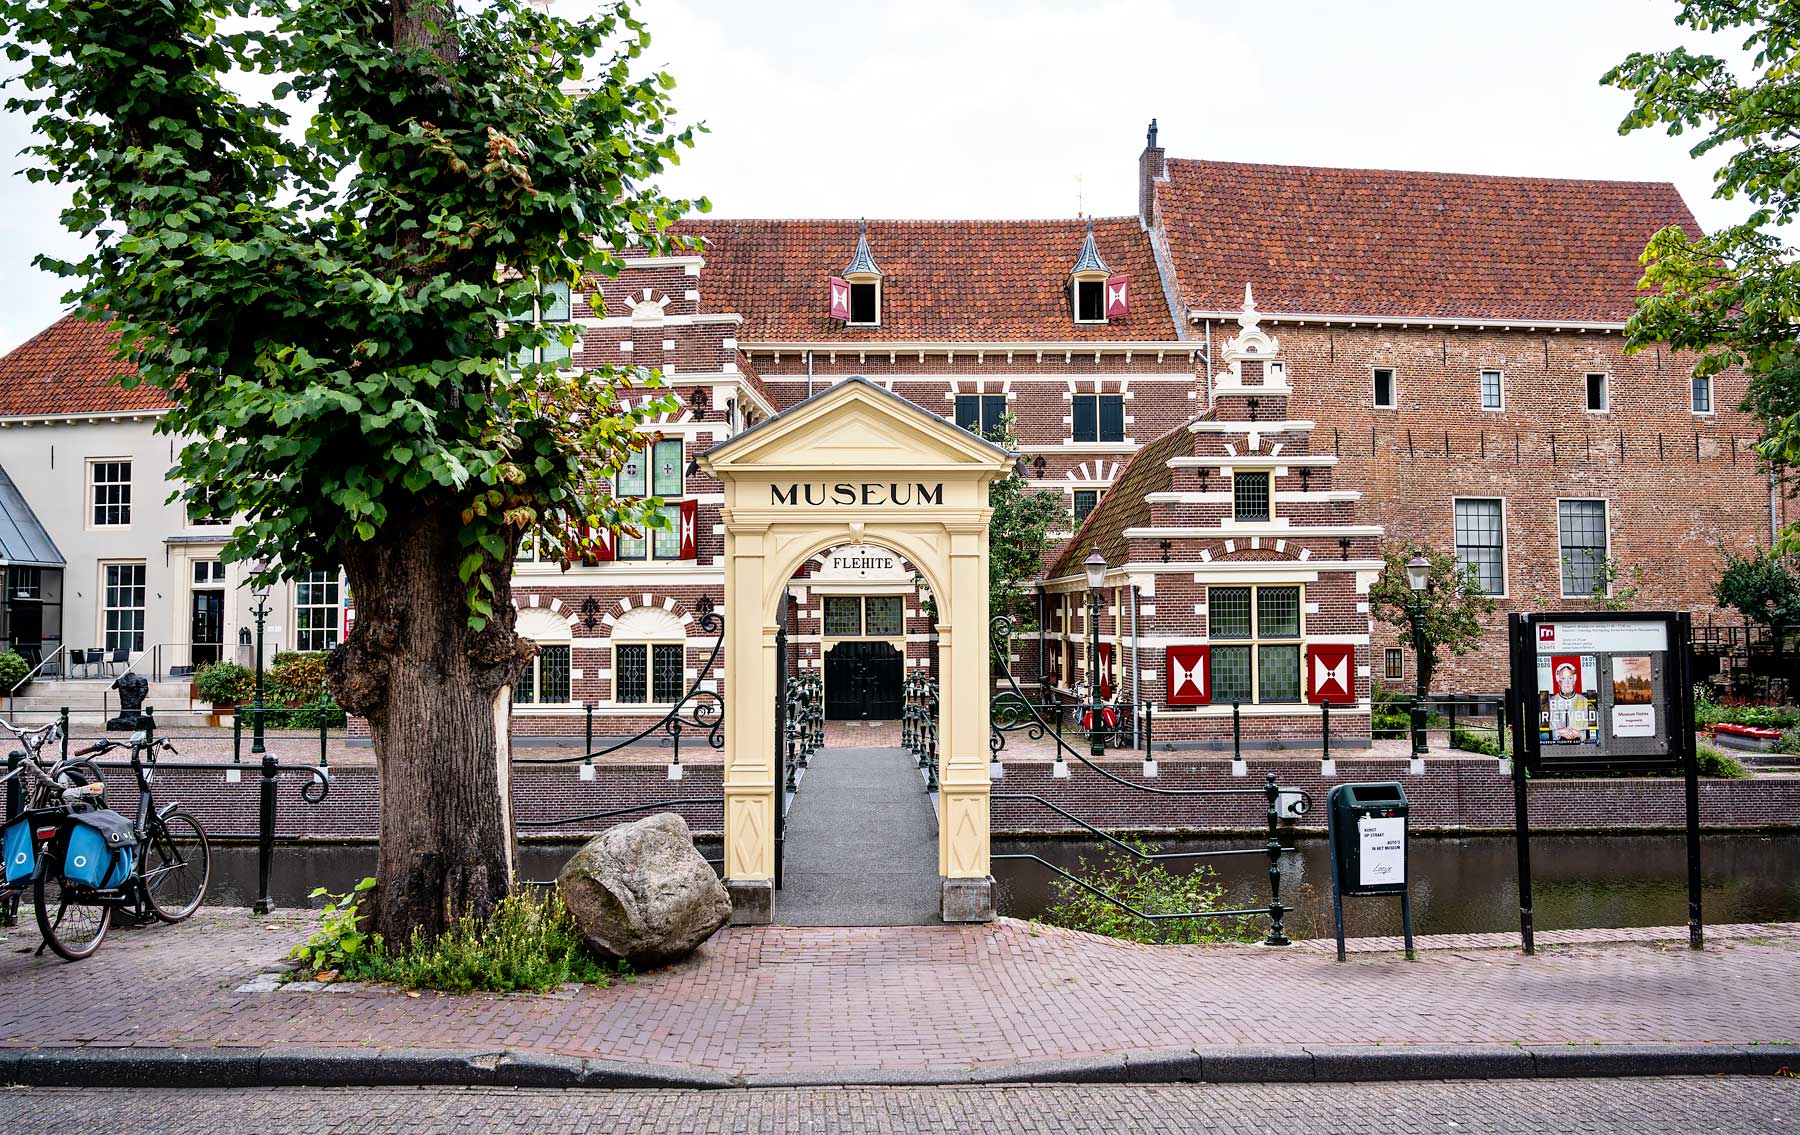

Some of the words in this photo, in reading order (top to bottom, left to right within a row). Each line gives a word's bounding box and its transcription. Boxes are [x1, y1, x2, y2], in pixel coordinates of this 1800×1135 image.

[770, 483, 944, 506] MUSEUM
[833, 557, 893, 569] FLEHITE
[1541, 710, 1596, 722] RIETVELD
